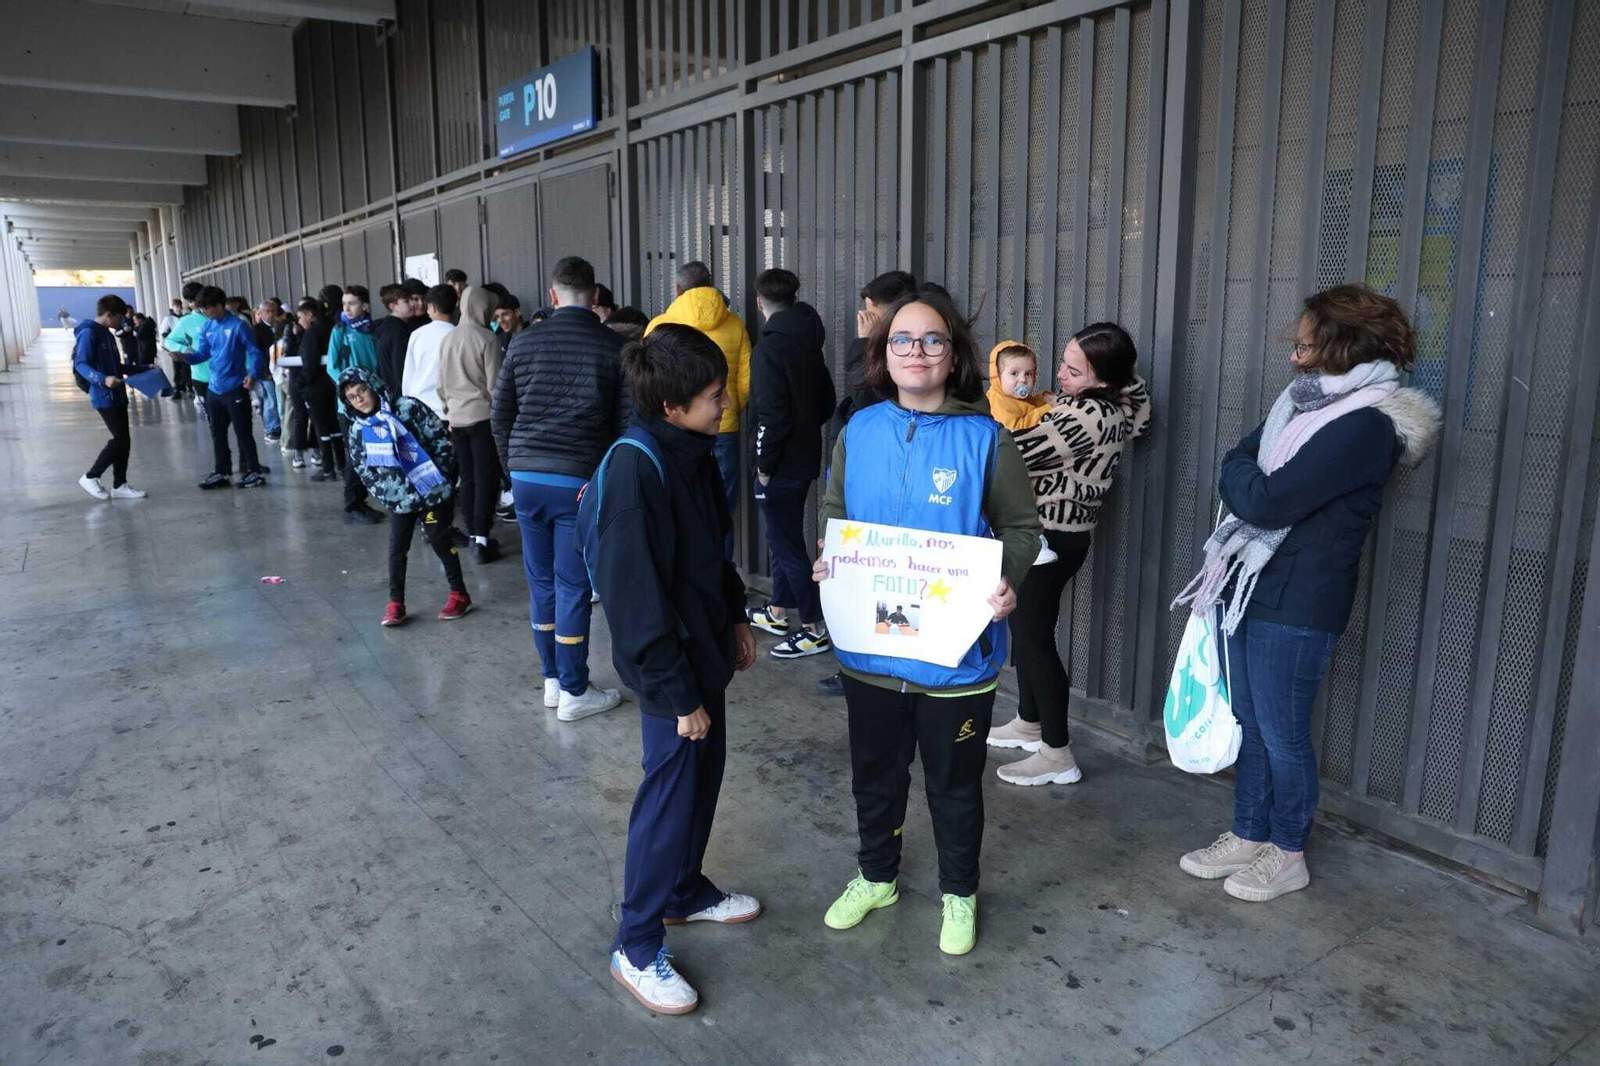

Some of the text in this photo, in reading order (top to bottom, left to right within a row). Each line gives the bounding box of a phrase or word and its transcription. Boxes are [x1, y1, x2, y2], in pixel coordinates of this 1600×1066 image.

[523, 73, 557, 127] P10
[928, 493, 953, 506] MCF
[926, 537, 955, 549] nos
[831, 550, 969, 579] podemos hacer una
[872, 574, 928, 600] FOTO?
